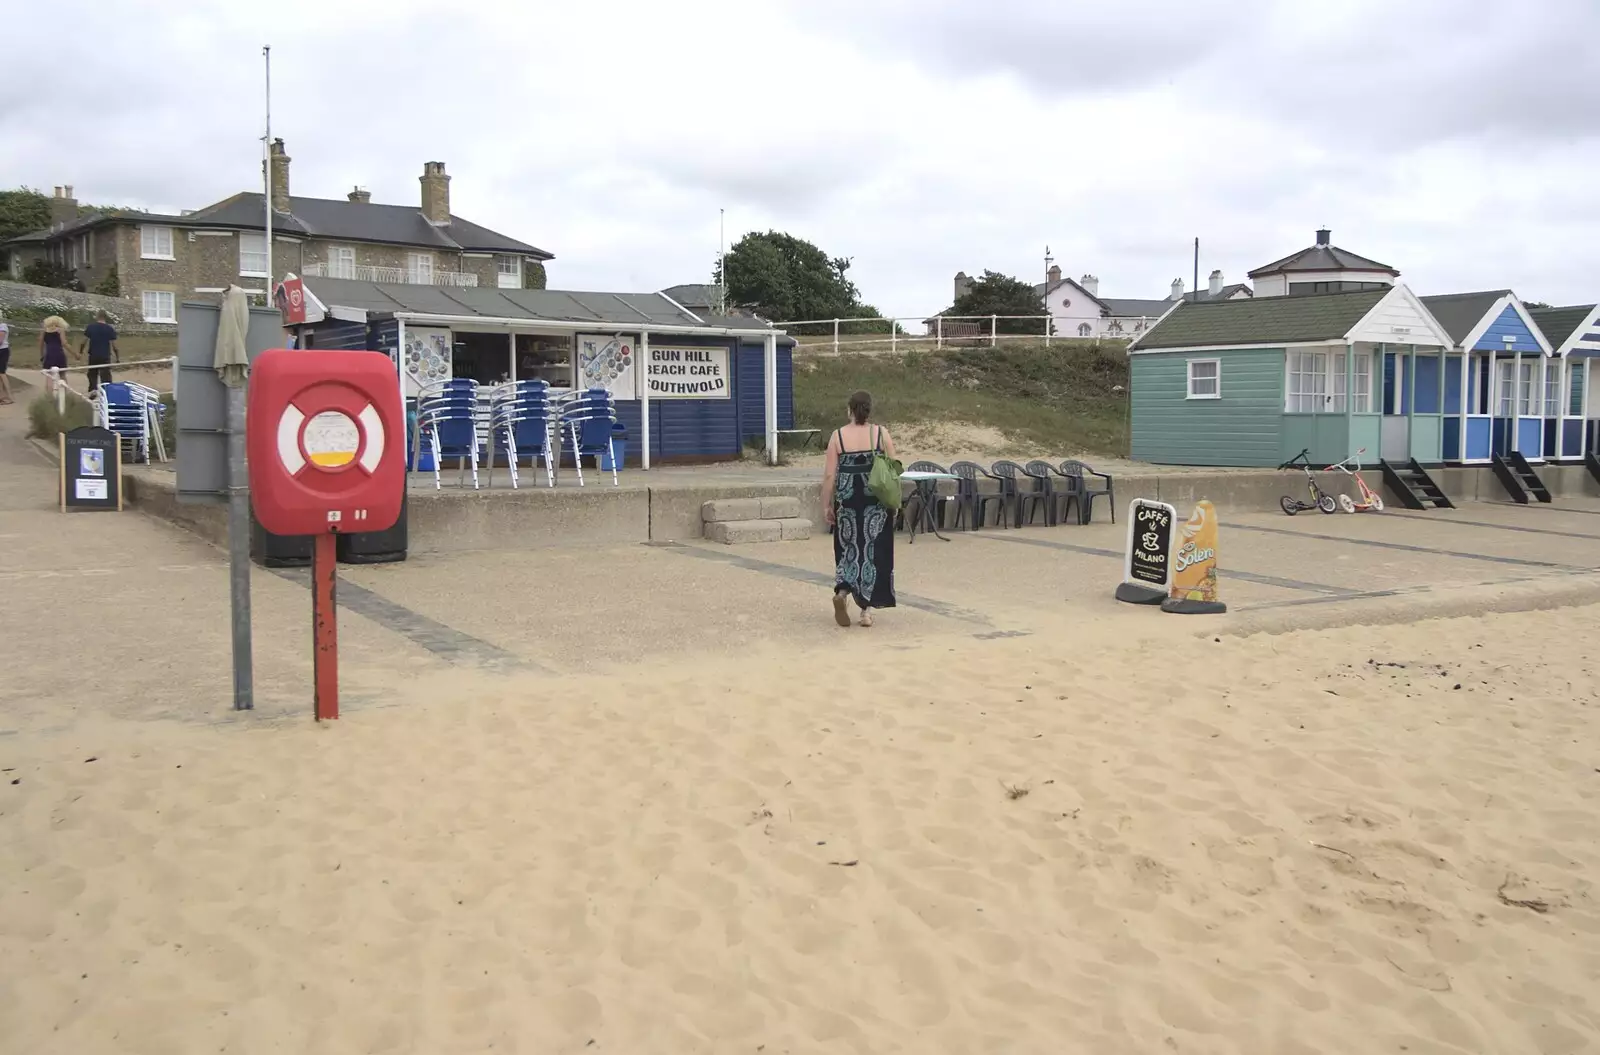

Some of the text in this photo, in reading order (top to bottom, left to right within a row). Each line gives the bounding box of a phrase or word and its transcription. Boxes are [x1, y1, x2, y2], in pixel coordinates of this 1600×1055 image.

[652, 350, 712, 362] GUN HILL
[690, 364, 720, 375] CAFÉ
[648, 378, 723, 393] OUTHWOLD
[1134, 548, 1165, 562] MILANO
